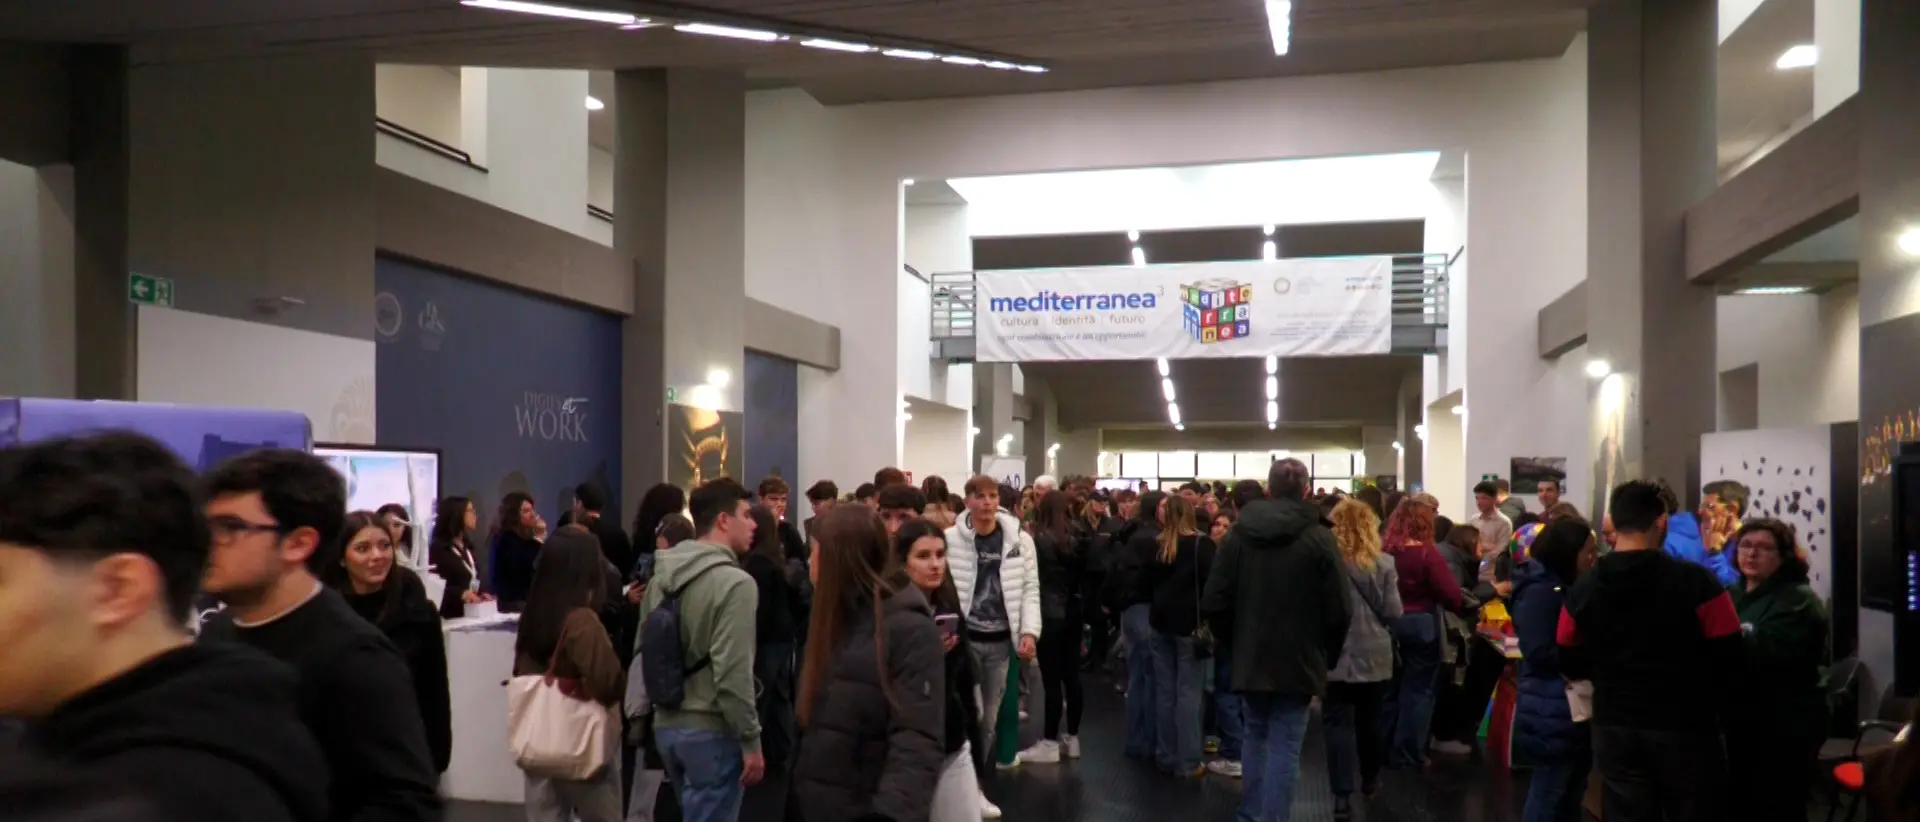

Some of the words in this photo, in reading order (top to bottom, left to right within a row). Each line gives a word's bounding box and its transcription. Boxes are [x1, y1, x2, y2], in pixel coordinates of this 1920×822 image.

[990, 290, 1156, 312] mediterranea
[1000, 315, 1039, 327] cultura
[1108, 312, 1146, 324] futuro
[515, 404, 588, 441] WORK
